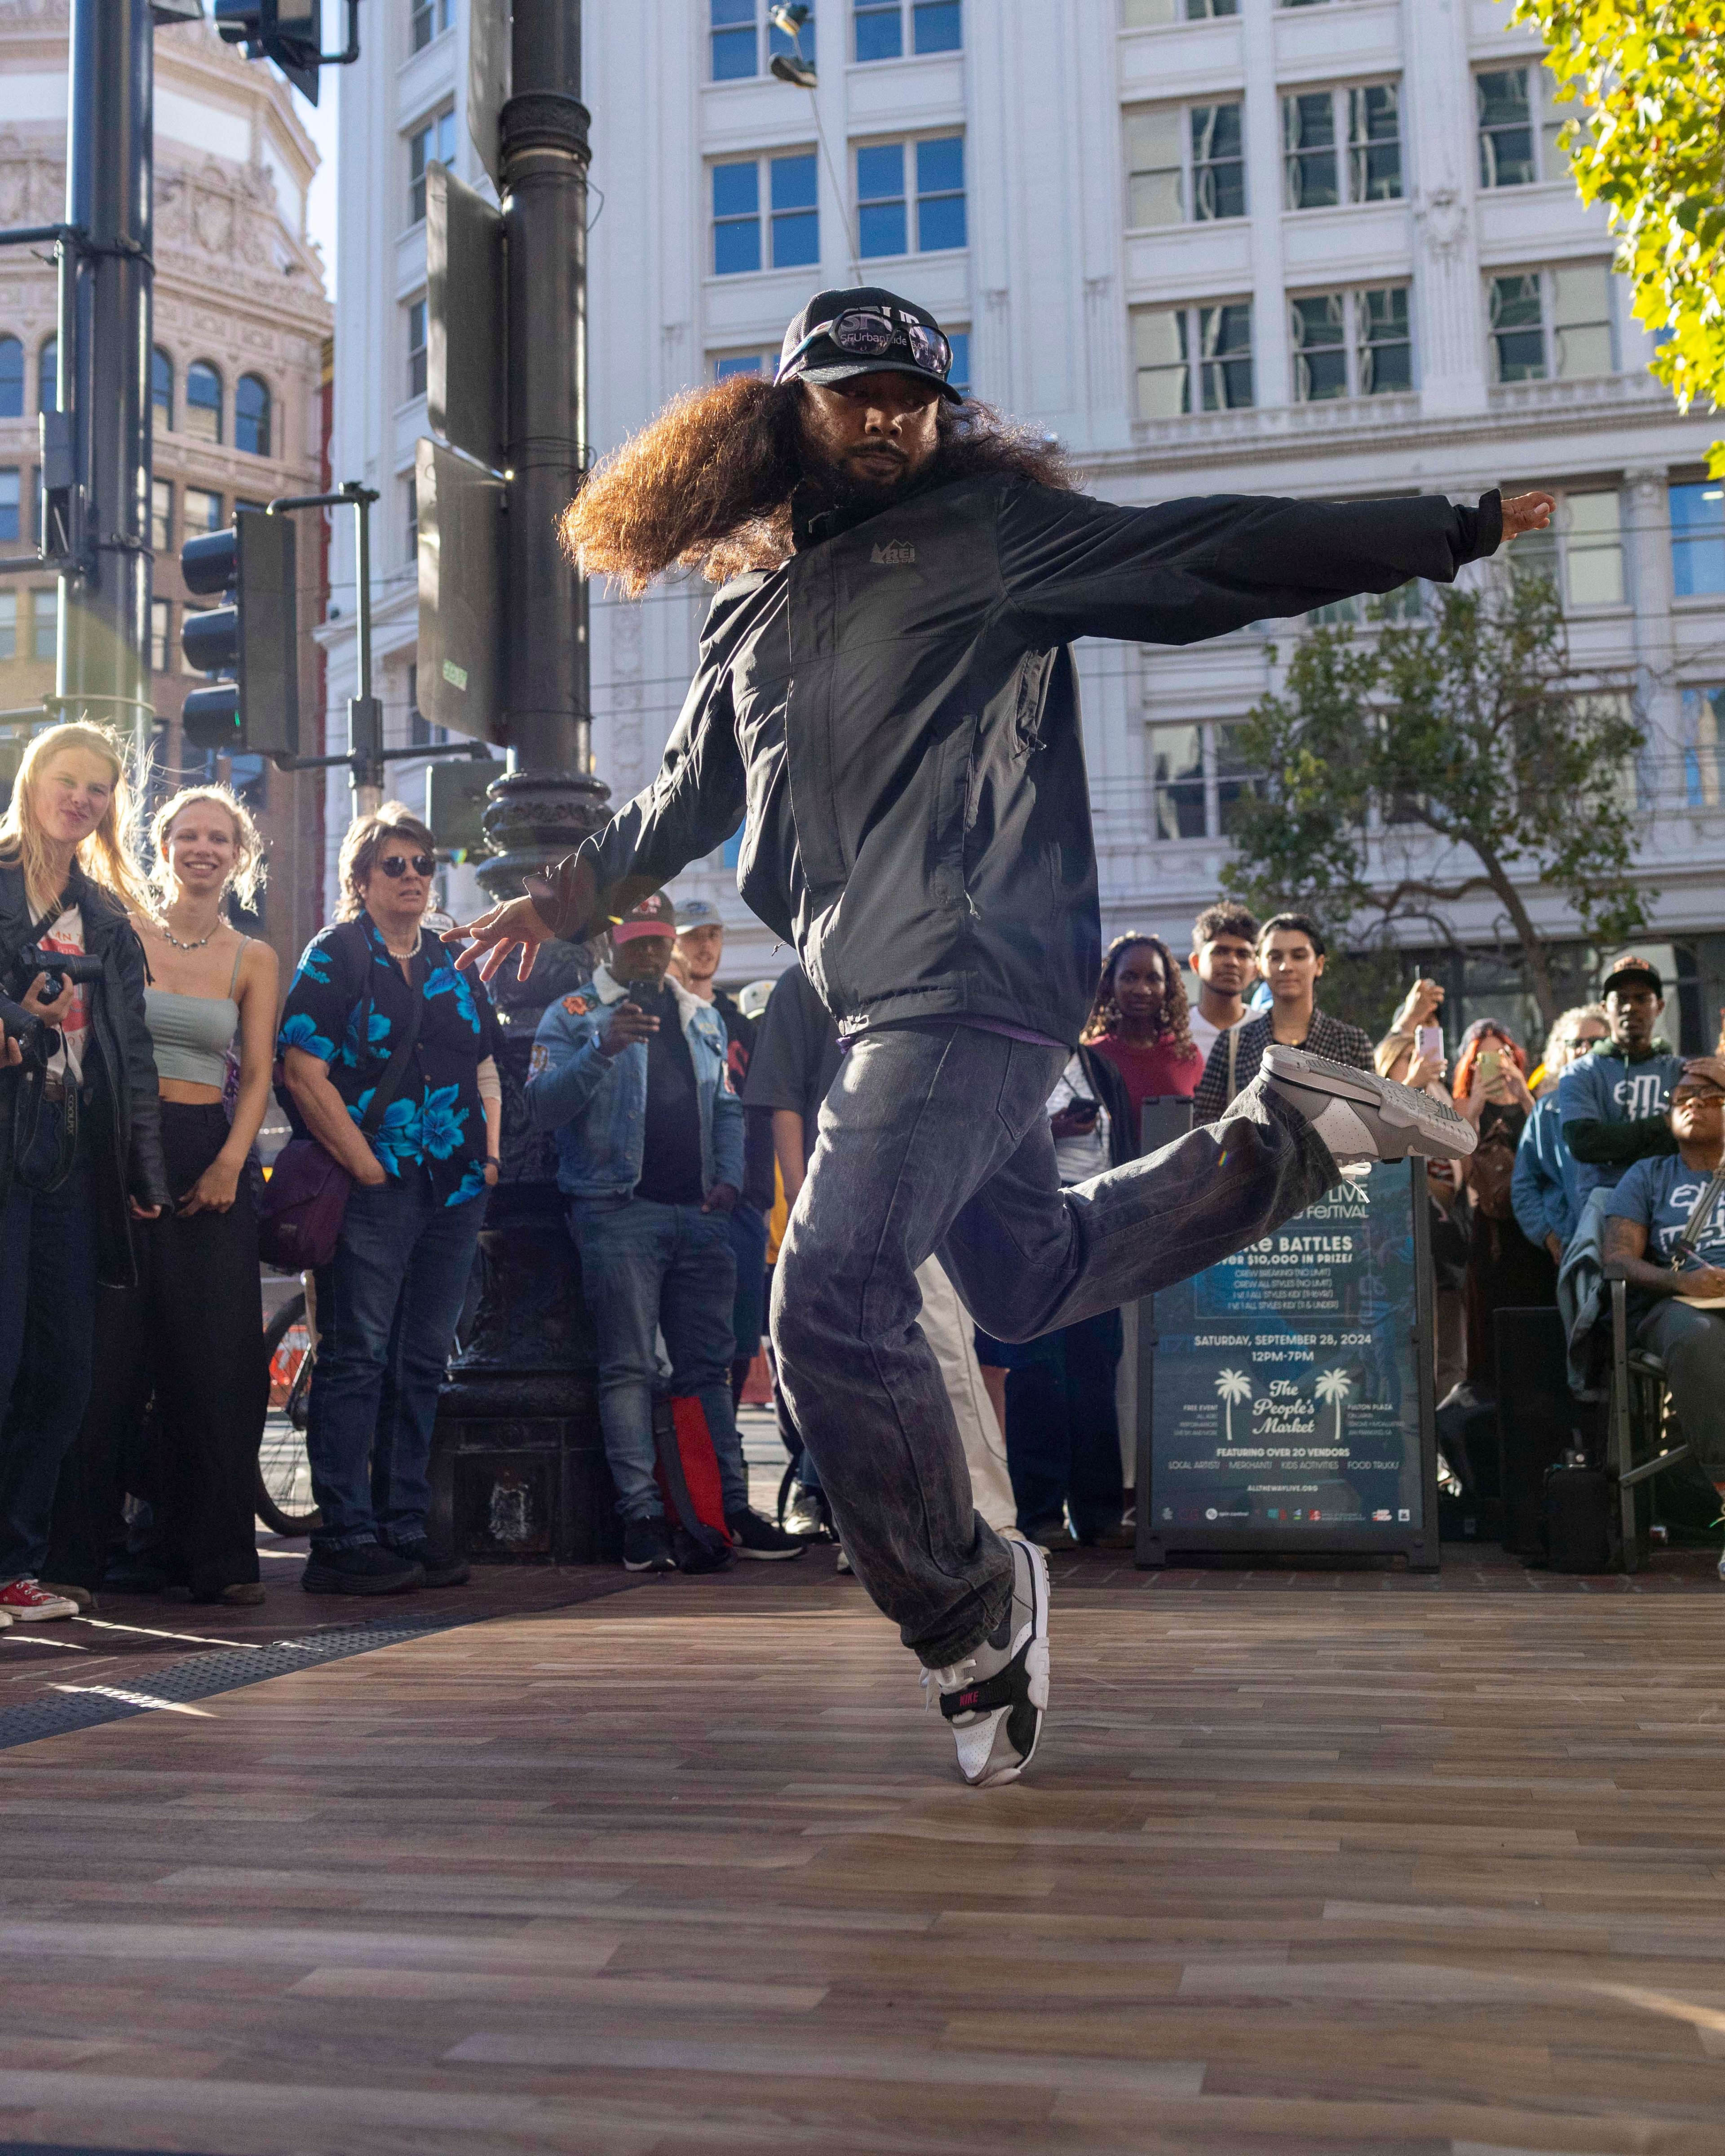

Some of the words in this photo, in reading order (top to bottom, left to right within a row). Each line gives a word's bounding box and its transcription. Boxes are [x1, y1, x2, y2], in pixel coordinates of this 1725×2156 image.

[886, 548, 915, 560] REI
[1328, 1183, 1368, 1203] LIVE
[1279, 1235, 1353, 1252] BATTLES
[1248, 1254, 1299, 1266] $10,000
[1302, 1254, 1314, 1263] IN
[1317, 1253, 1353, 1263] PRIZES
[1194, 1335, 1252, 1346] SATURDAY,
[1255, 1334, 1317, 1346] SEPTEMBER
[1320, 1334, 1337, 1346] 28,
[1340, 1334, 1372, 1346] 2024
[1252, 1351, 1314, 1362] 12PM-7PM
[1269, 1380, 1298, 1397] The
[1252, 1398, 1315, 1420] People's
[1252, 1417, 1315, 1434] Market
[1216, 1448, 1265, 1457] FEATURING
[1266, 1448, 1291, 1457] OVER
[1292, 1448, 1306, 1457] 20
[1307, 1448, 1350, 1457] VENDORS
[1168, 1461, 1192, 1470] LOCAL
[1281, 1461, 1298, 1470] KIDS
[1348, 1461, 1371, 1470] FOOD
[1373, 1461, 1399, 1470] TRUCKS
[960, 1691, 978, 1707] NIKE
